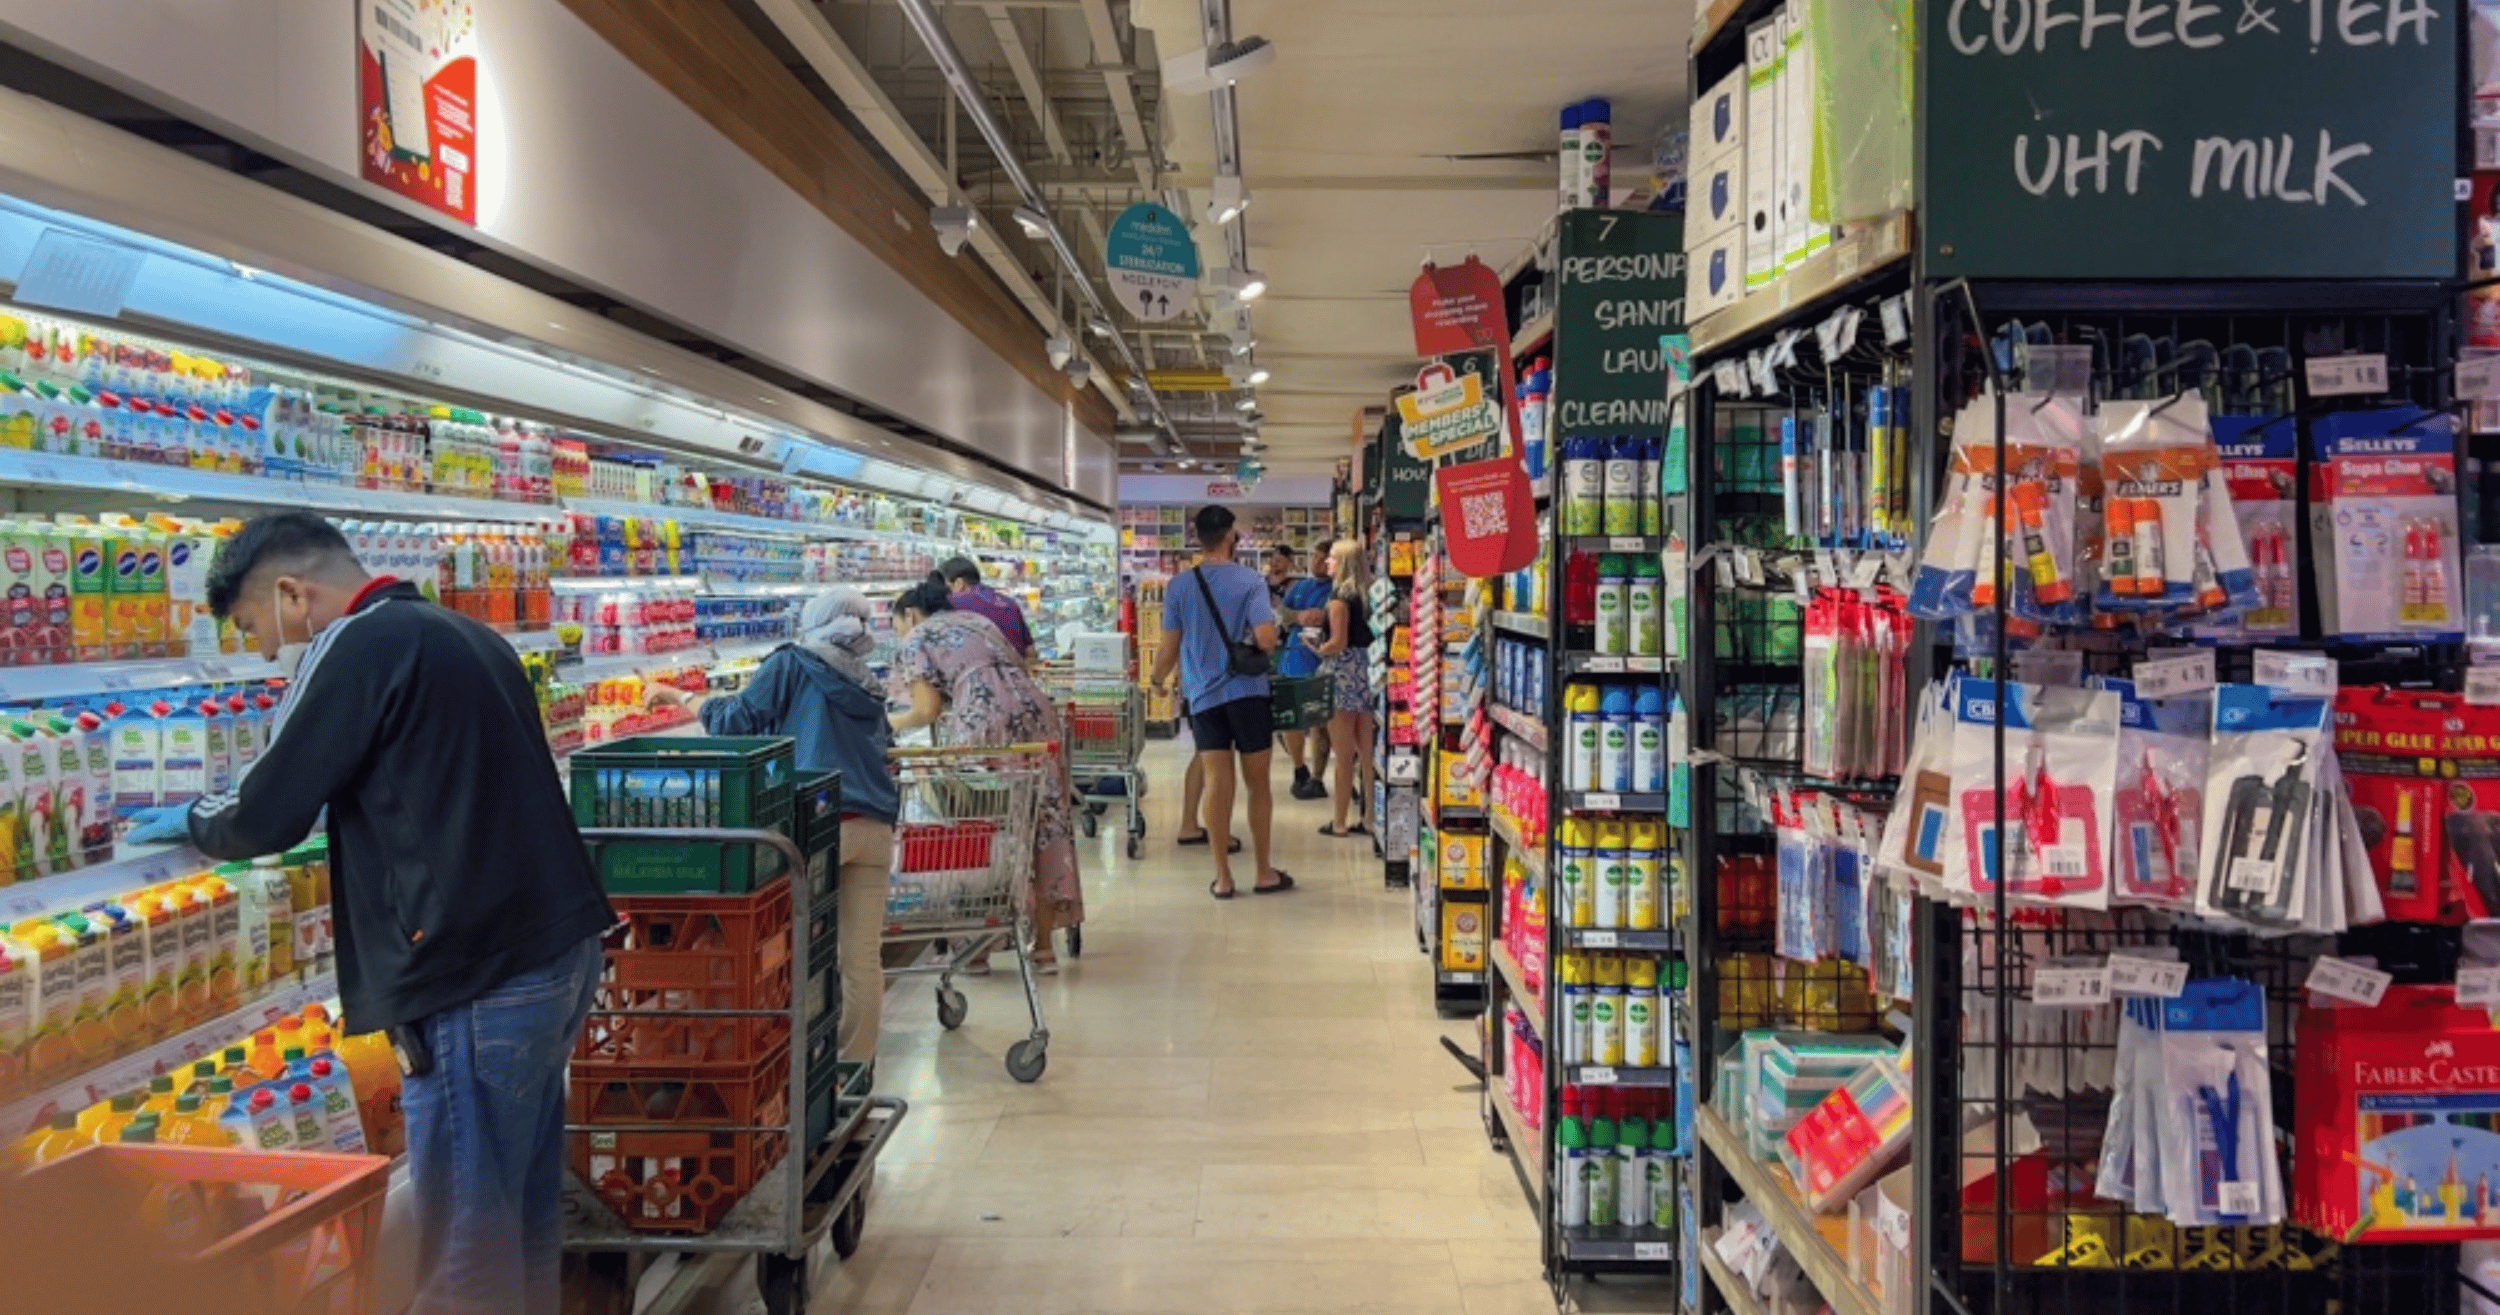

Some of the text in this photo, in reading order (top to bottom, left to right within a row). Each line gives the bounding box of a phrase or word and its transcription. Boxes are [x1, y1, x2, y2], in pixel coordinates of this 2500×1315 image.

[1947, 0, 2224, 55] COFFEE
[2014, 129, 2372, 206] UHT MILK
[1600, 216, 1618, 241] 7
[1429, 415, 1496, 447] SPECIAL
[2338, 437, 2417, 452] SELLEYS
[2341, 460, 2421, 477] Supa Glue
